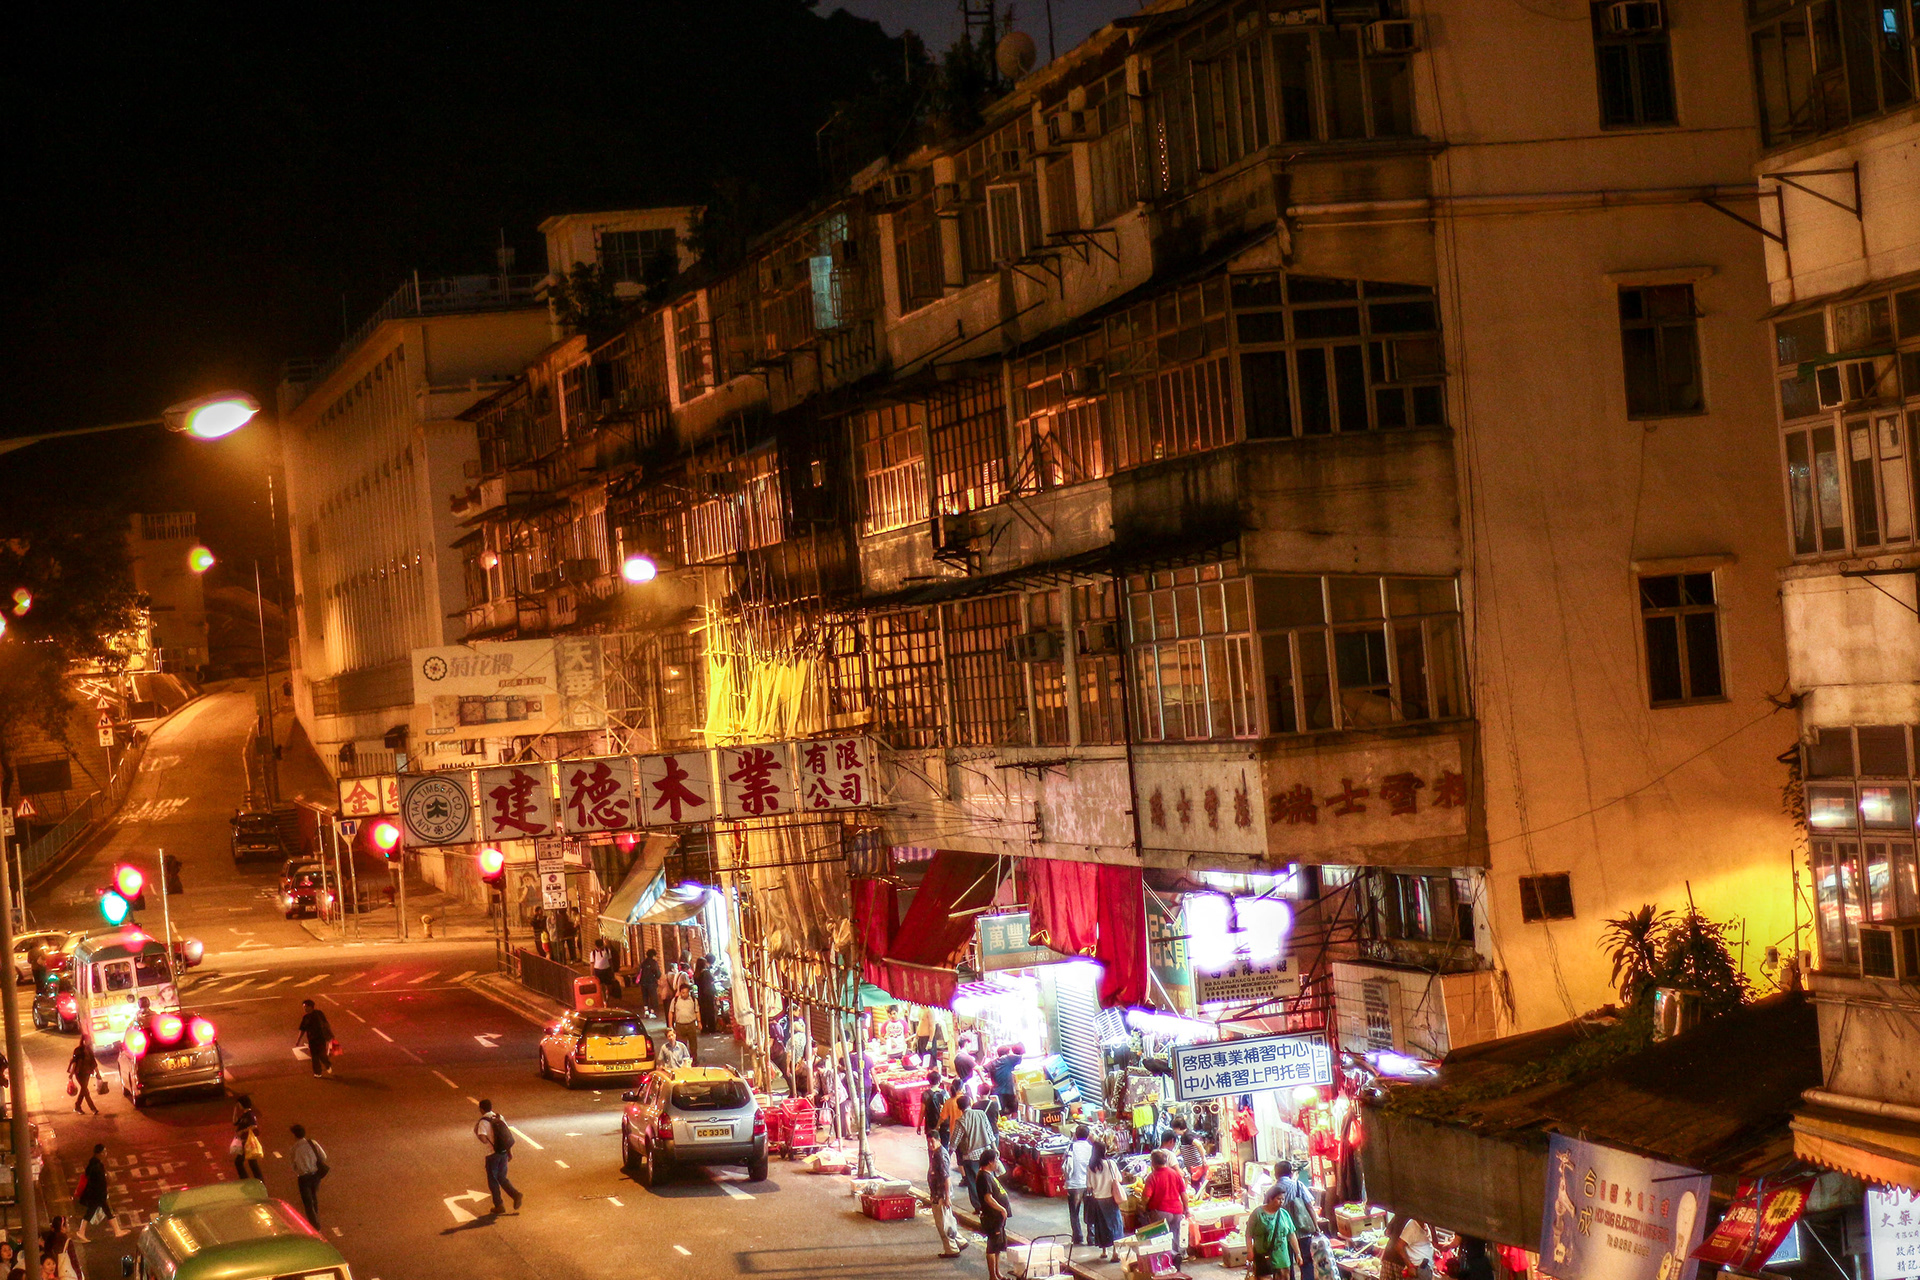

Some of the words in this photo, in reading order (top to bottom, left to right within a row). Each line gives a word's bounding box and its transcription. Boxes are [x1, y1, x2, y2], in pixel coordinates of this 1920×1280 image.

[416, 783, 454, 798] TIMBER
[488, 747, 782, 835] 建德木業
[411, 799, 420, 818] TAK
[416, 818, 432, 834] KIN
[988, 922, 1031, 951] 萬豐
[1183, 1062, 1311, 1092] 中小補習上門托管
[1880, 1210, 1920, 1228] 大藥
